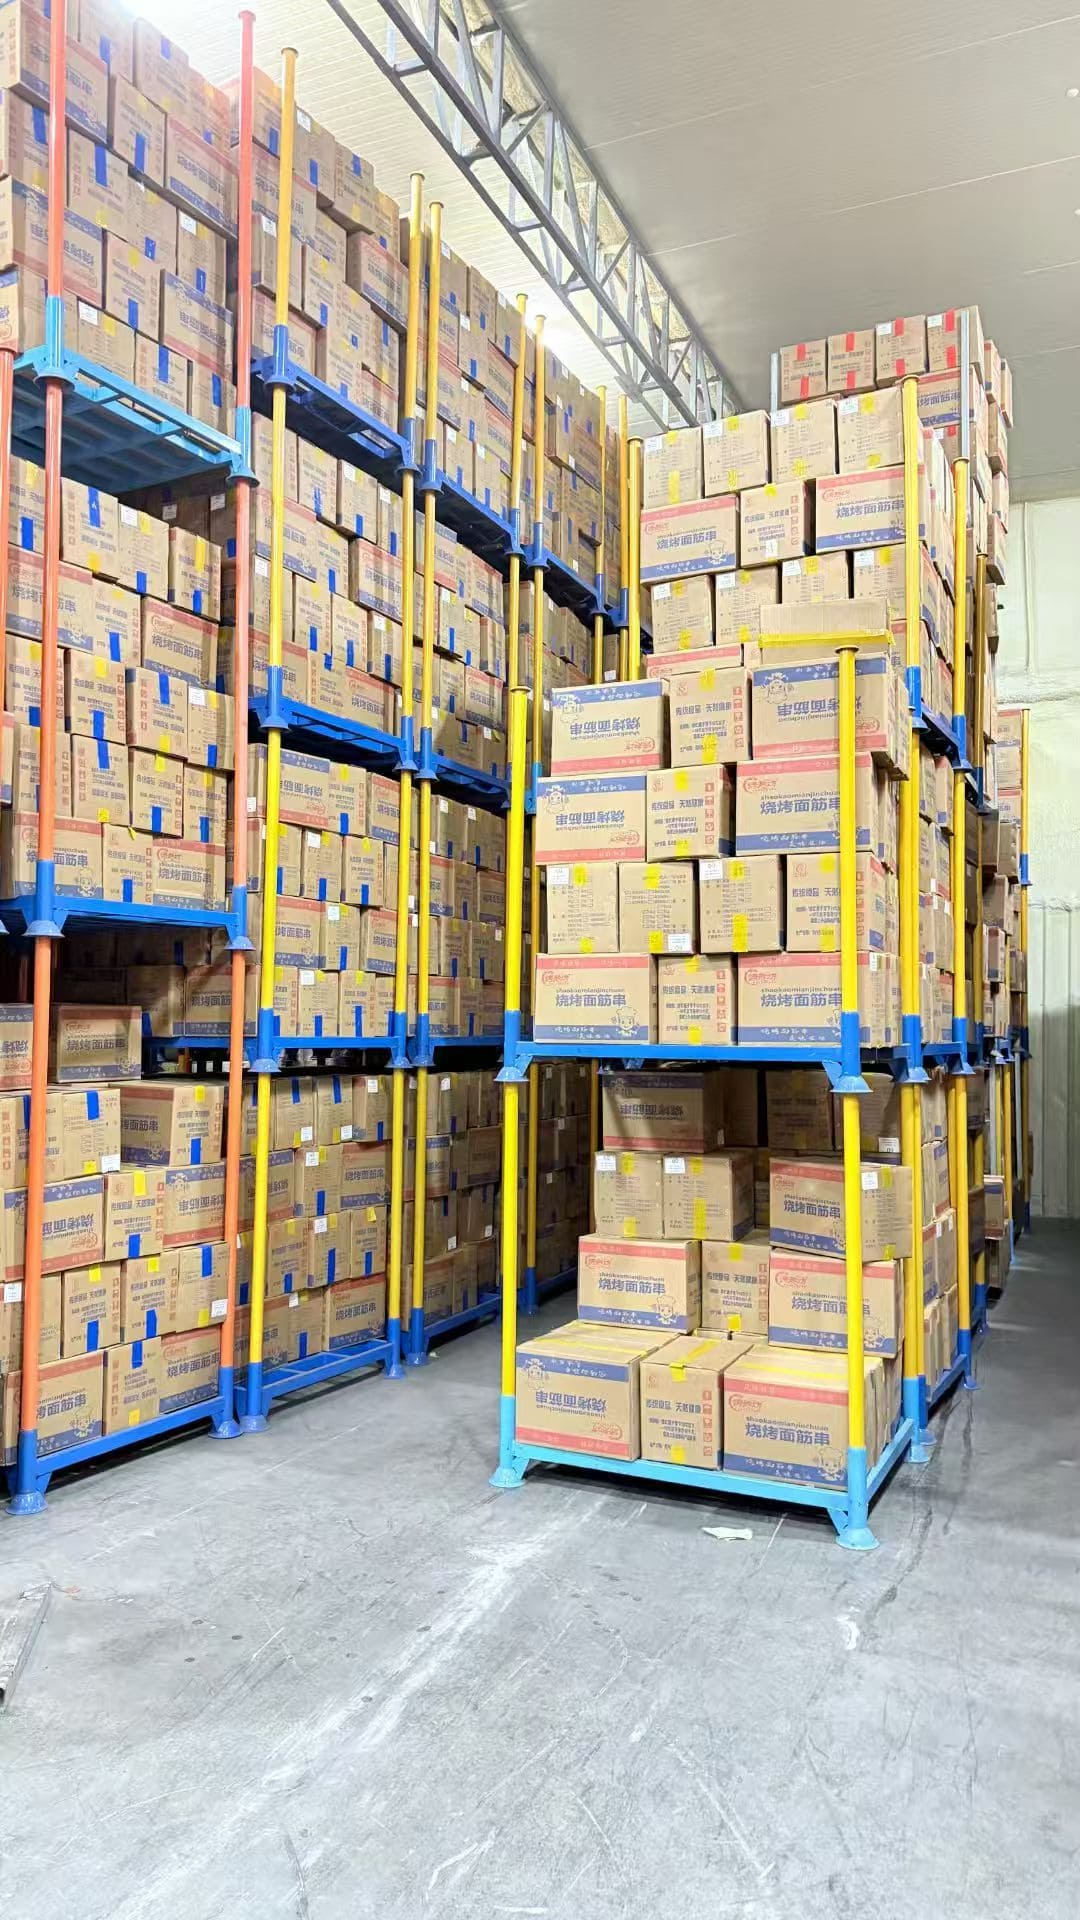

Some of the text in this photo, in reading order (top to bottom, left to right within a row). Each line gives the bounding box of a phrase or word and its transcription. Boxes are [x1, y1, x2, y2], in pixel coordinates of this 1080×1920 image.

[556, 810, 625, 826] 烧烤面筋串
[26, 850, 89, 868] 烧面筋串
[556, 994, 626, 1007] 烧烤面筋串
[760, 993, 842, 1008] 烧烤面筋串
[784, 1200, 840, 1218] 烧烤面筋串
[598, 1278, 666, 1296] 烧烤面筋串
[37, 1394, 86, 1420] 烤面筋串
[535, 1390, 607, 1414] 烧烤面筋串
[745, 1422, 830, 1446] 烧烤面筋串
